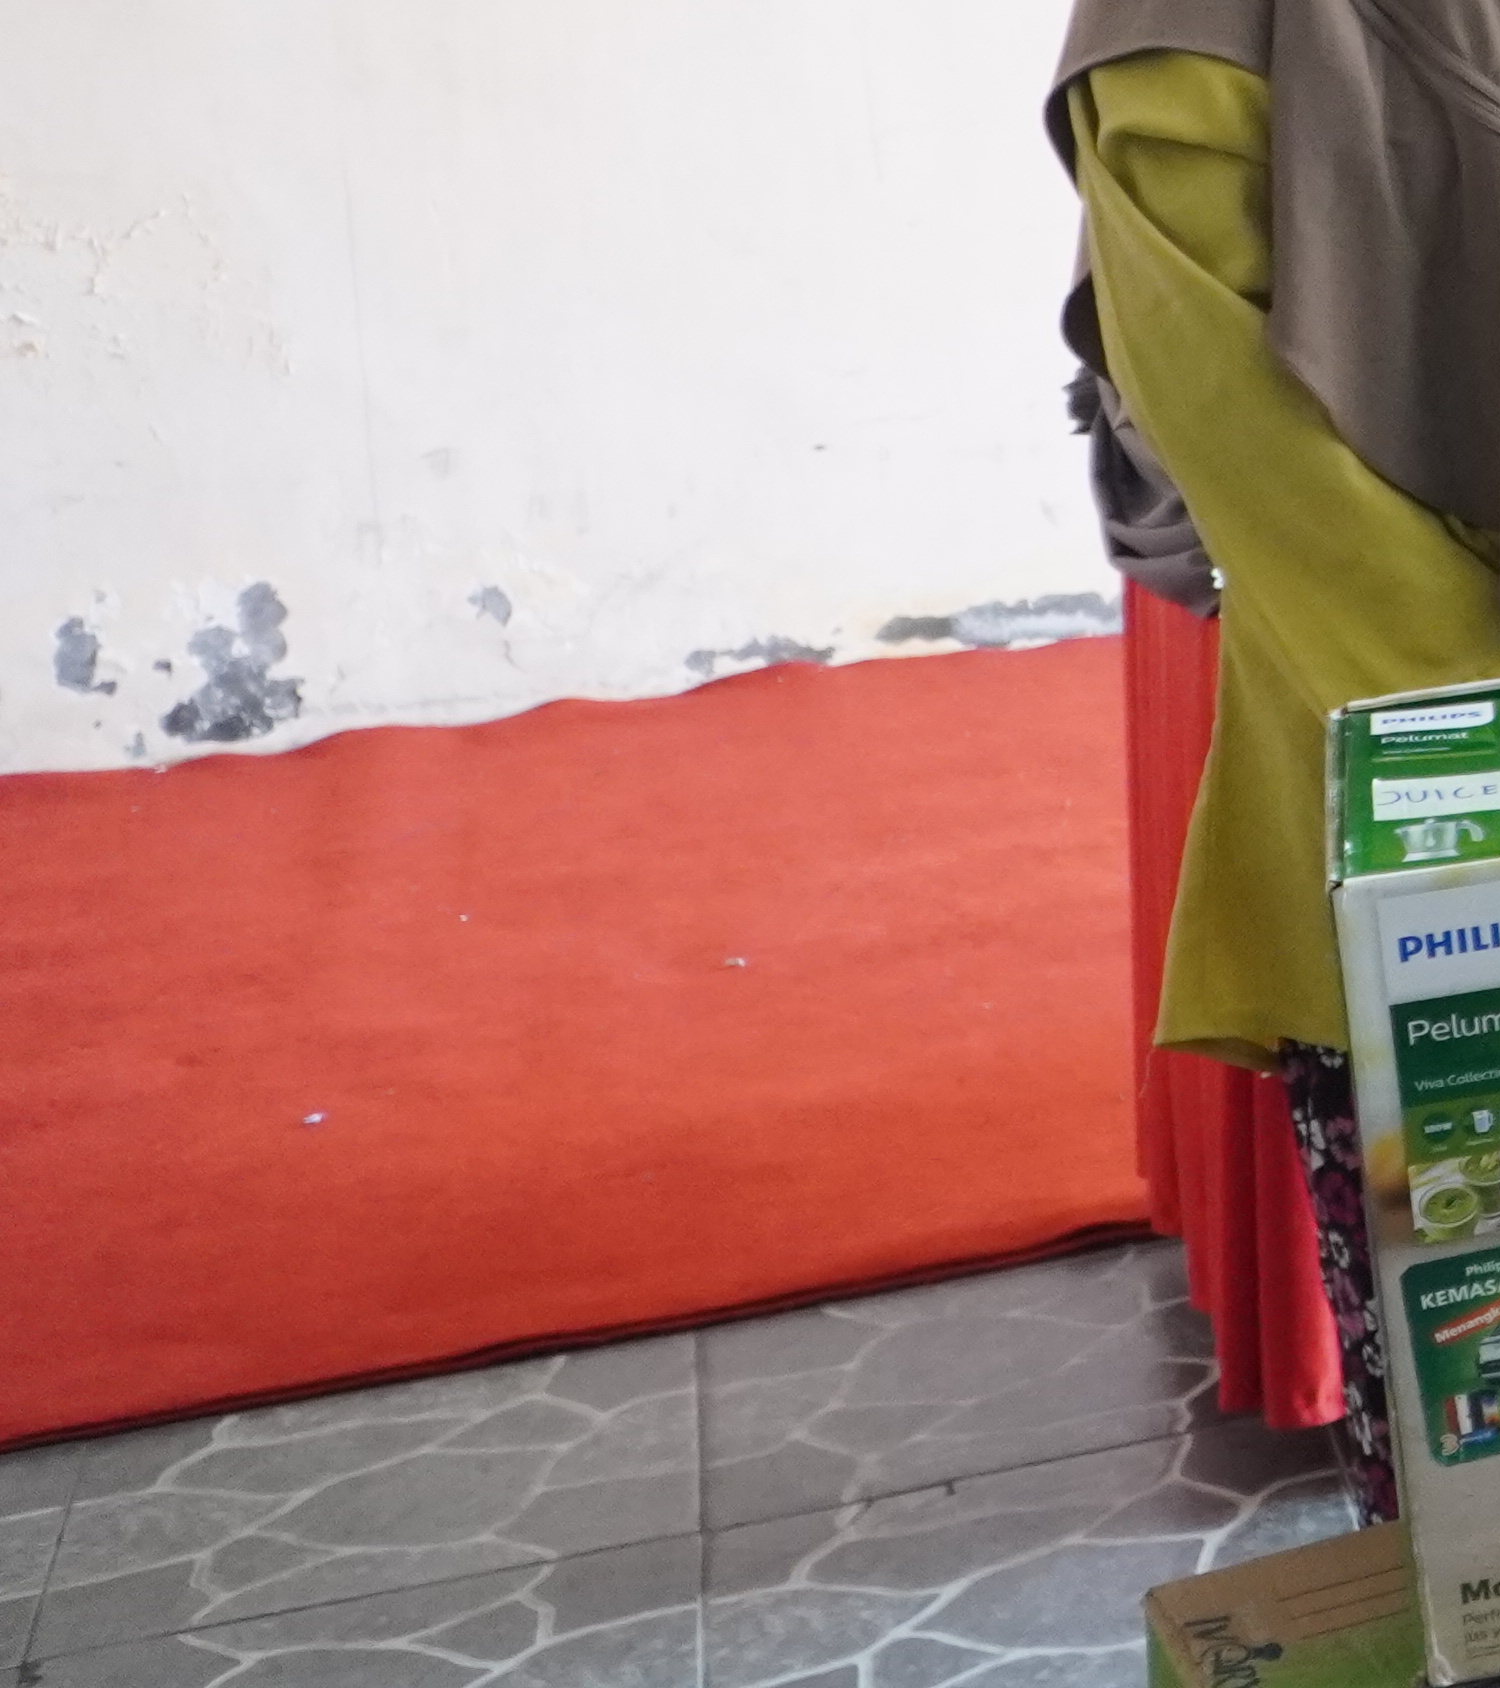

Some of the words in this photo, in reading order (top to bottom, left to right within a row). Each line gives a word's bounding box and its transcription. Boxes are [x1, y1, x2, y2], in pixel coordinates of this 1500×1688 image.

[1381, 711, 1483, 725] PHILIPS
[1380, 731, 1470, 745] Pelumat
[1376, 784, 1499, 807] JUICE
[1415, 1078, 1444, 1092] Viva
[1439, 1433, 1459, 1456] 3
